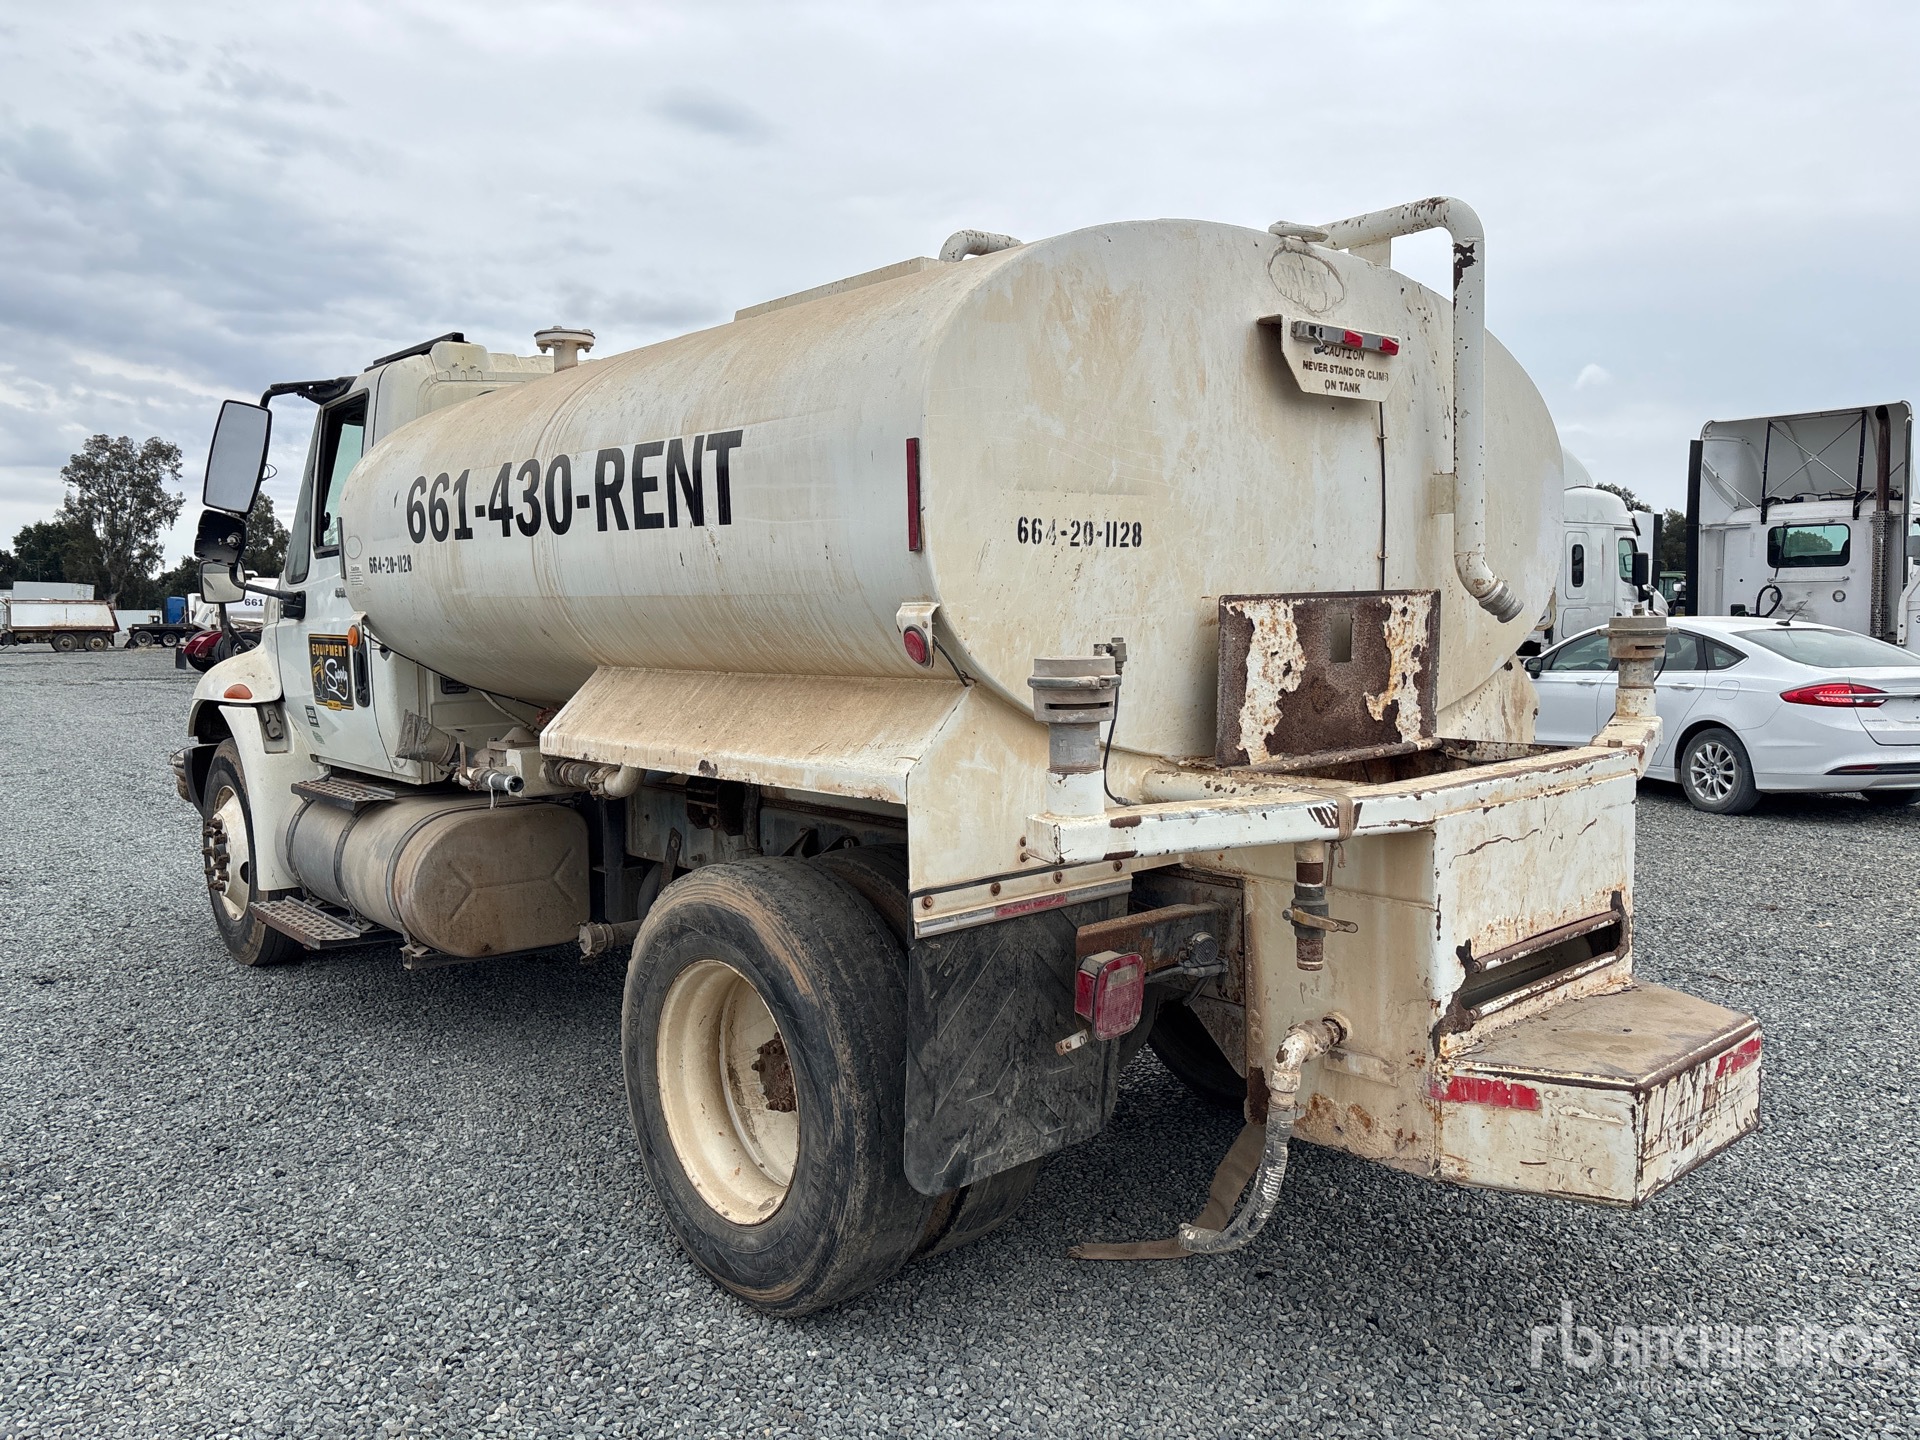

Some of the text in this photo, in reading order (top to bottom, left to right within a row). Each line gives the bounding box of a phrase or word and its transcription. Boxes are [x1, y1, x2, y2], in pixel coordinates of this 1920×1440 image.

[1324, 345, 1365, 361] CAUTION
[1302, 360, 1328, 373] NEVER
[1329, 365, 1354, 377] STAND
[1355, 369, 1365, 379] OR
[1324, 379, 1361, 393] ON TANK
[406, 429, 744, 544] 661-430-RENT
[1017, 516, 1142, 547] 664-20-1128
[368, 554, 412, 573] 664-20-1128
[311, 643, 347, 657] EQUIPMENT
